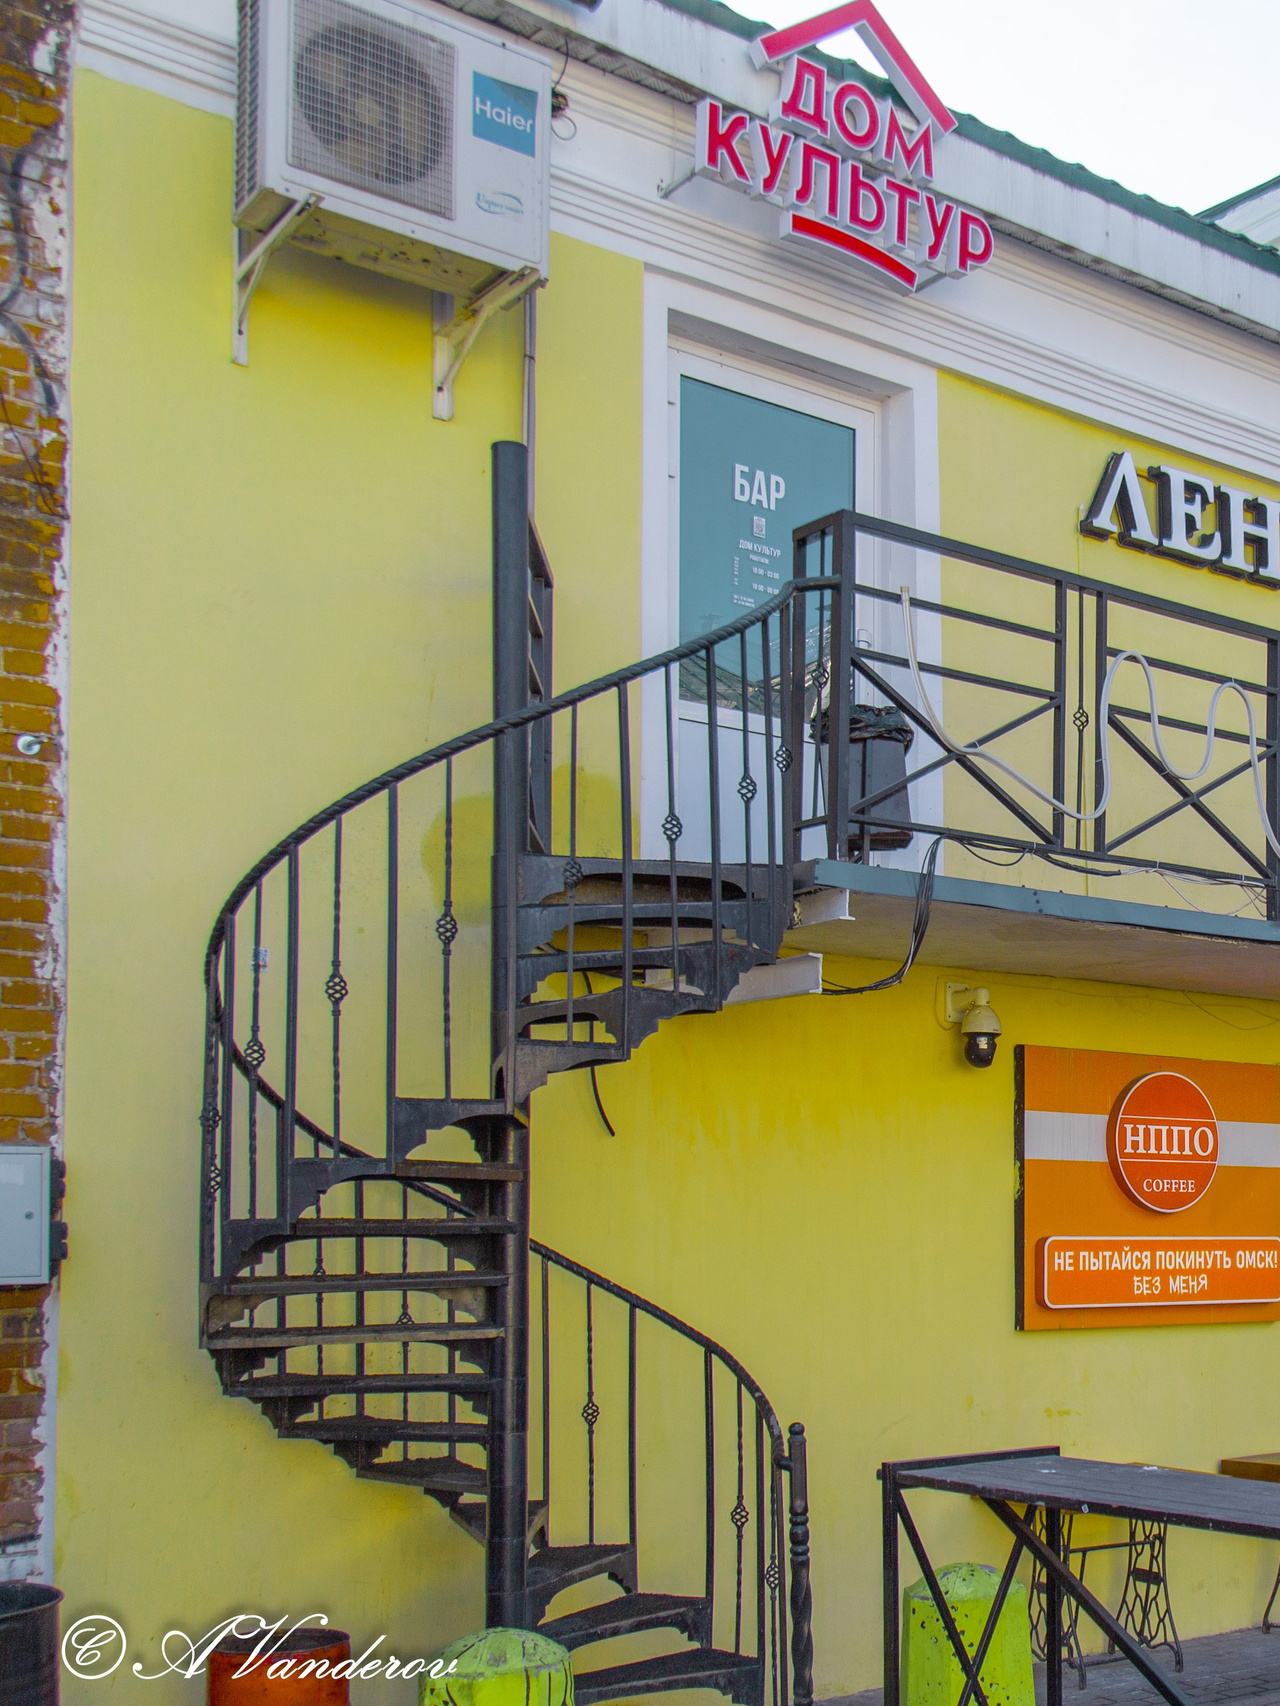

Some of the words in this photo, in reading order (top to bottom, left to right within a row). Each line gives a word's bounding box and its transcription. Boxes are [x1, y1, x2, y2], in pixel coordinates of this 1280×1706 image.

[474, 96, 534, 134] Haier
[779, 54, 935, 183] ДОМ
[702, 98, 995, 275] КУЛЬТУР
[733, 463, 786, 511] БАР
[738, 539, 753, 551] ДОМ
[753, 543, 781, 558] КУЛЬТУР
[1123, 1123, 1215, 1157] НППО
[1143, 1178, 1196, 1193] COFFEE
[1054, 1250, 1074, 1271] НЕ
[1079, 1246, 1151, 1271] ПЫТАЙСЯ
[1155, 1250, 1232, 1270] ПОКИНУТЬ
[1235, 1250, 1278, 1269] ОМСК!
[1133, 1275, 1161, 1295] БЕЗ
[1169, 1274, 1208, 1295] МЕНЯ
